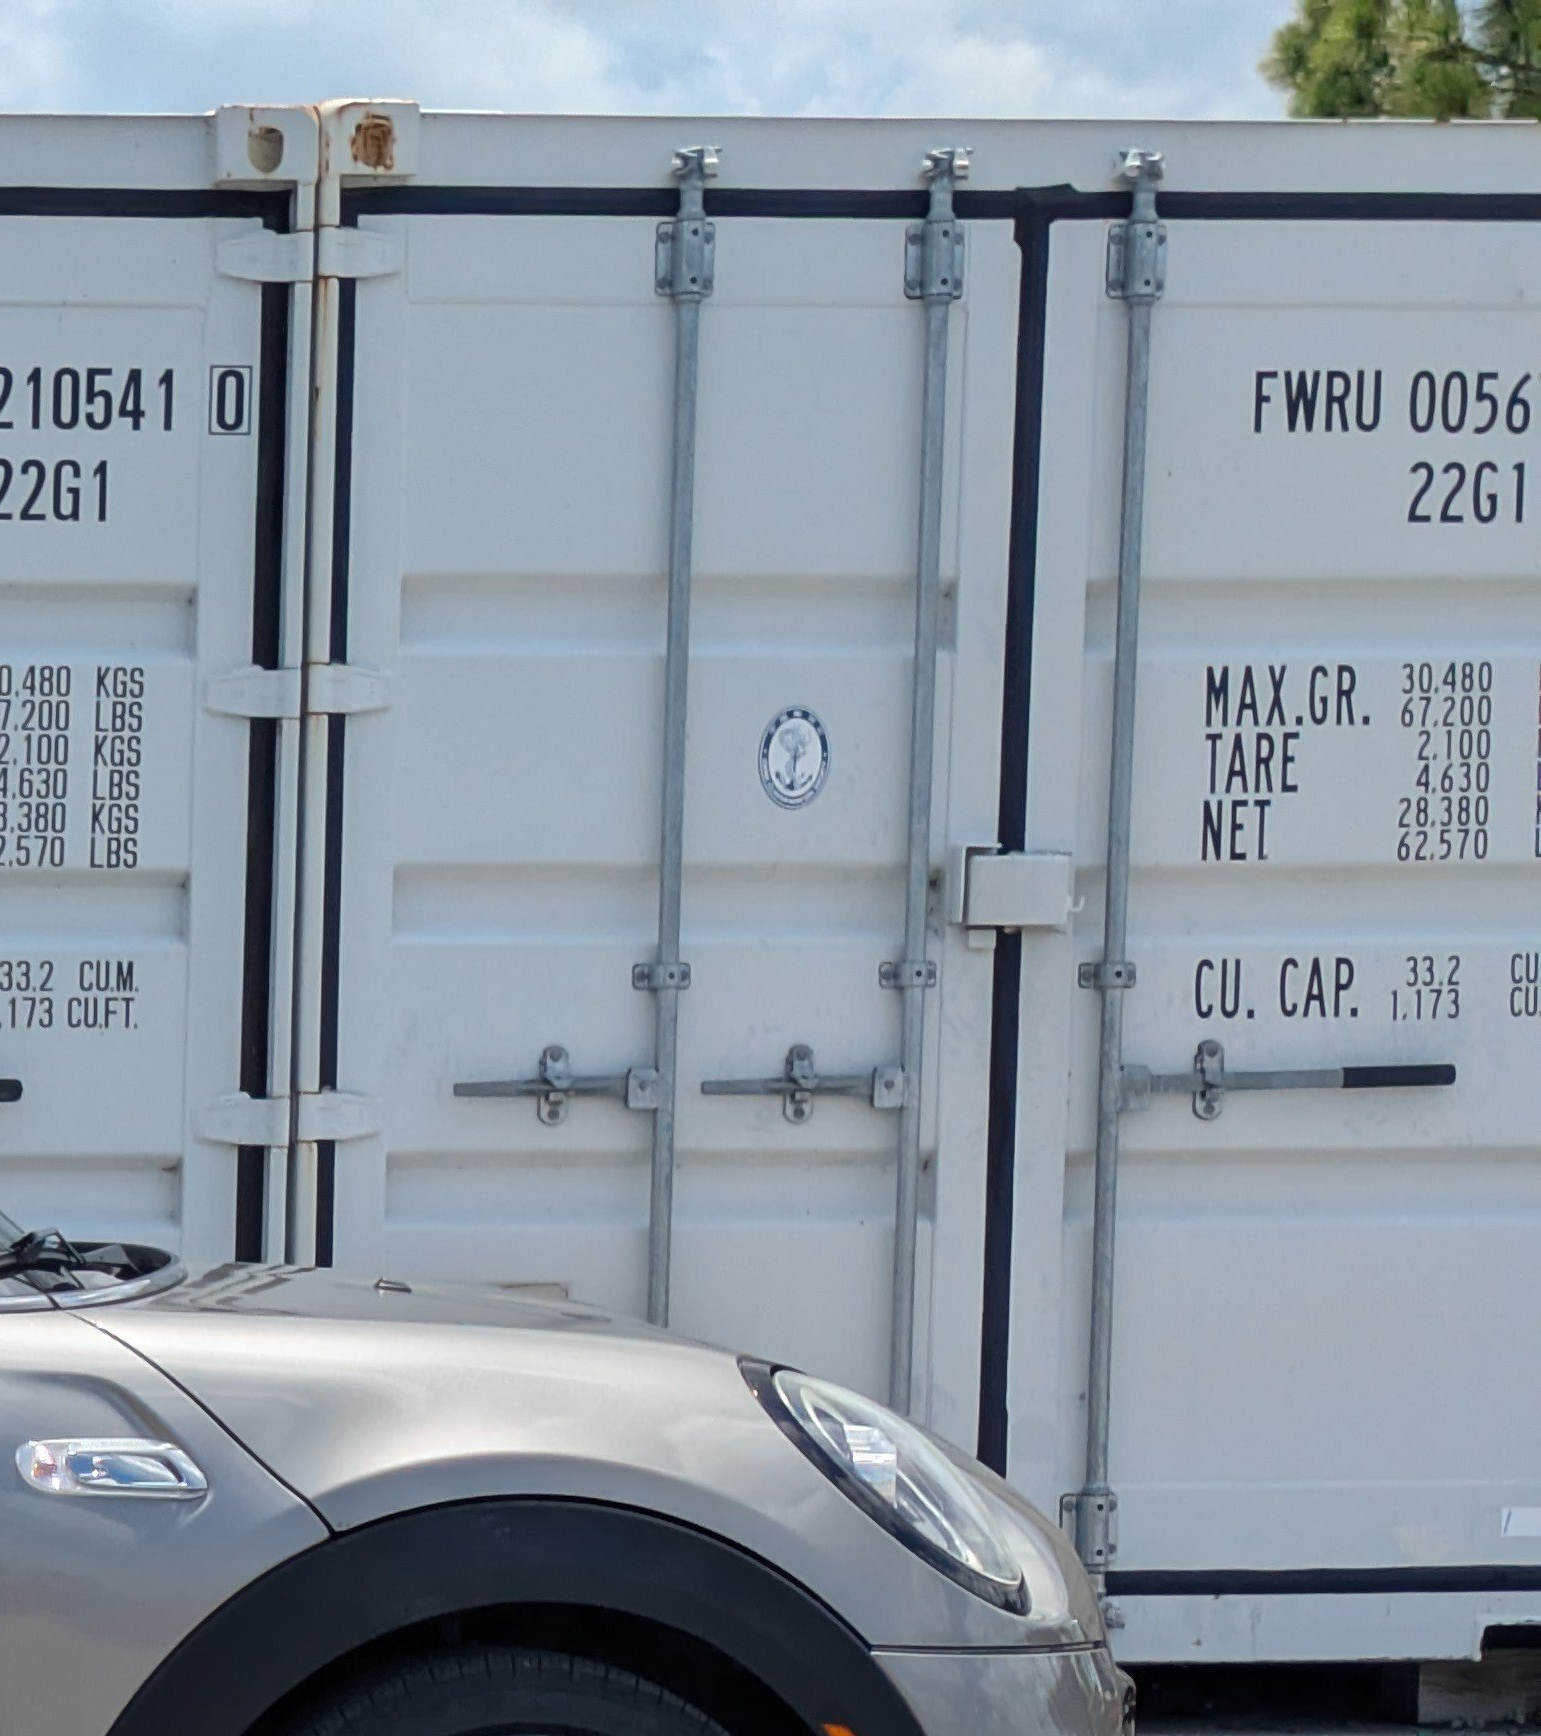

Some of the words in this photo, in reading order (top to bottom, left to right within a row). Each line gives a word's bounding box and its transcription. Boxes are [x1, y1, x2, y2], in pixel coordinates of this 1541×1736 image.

[217, 370, 244, 431] 0
[1254, 370, 1381, 433] FWRU
[1410, 371, 1541, 434] 0056
[1408, 461, 1524, 523] 22G1
[97, 667, 144, 698] KGS
[95, 701, 142, 732] LBS
[94, 735, 141, 769] KGS
[1206, 732, 1299, 794] TARE
[93, 769, 139, 801] LBS
[92, 802, 138, 834] KGS
[1202, 799, 1271, 861] NET
[90, 837, 137, 868] LBS
[0, 961, 53, 992] 33.2
[1195, 959, 1254, 1019] CU.
[1280, 957, 1358, 1017] CAP.
[1406, 956, 1460, 988] 33.2
